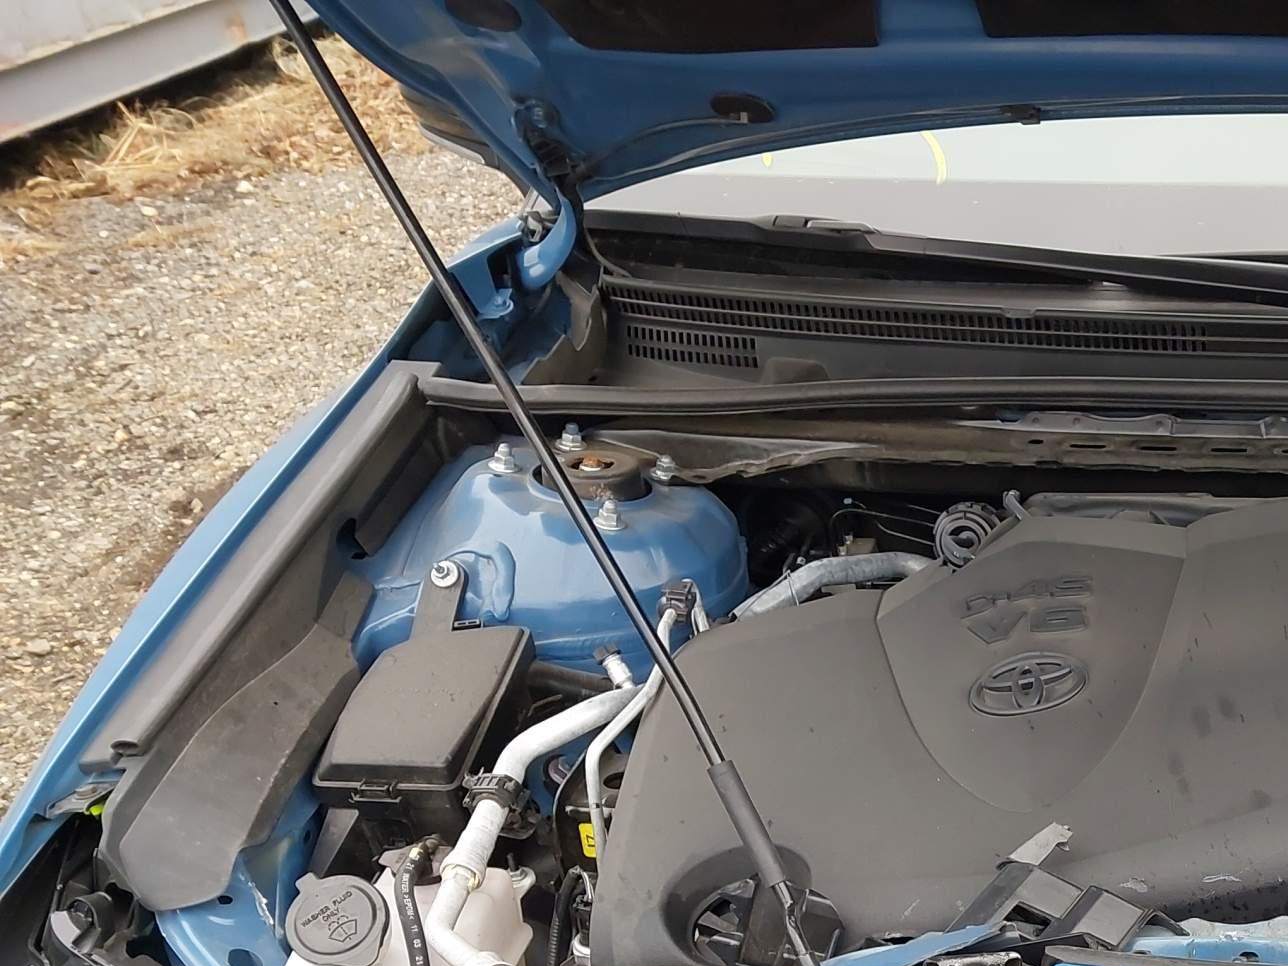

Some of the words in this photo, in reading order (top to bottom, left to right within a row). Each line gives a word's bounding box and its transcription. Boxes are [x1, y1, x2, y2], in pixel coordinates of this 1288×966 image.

[300, 905, 331, 927] WASHER
[332, 890, 353, 906] FLUID
[322, 907, 340, 923] ONLY
[401, 873, 411, 893] WATER
[415, 955, 424, 965] 21
